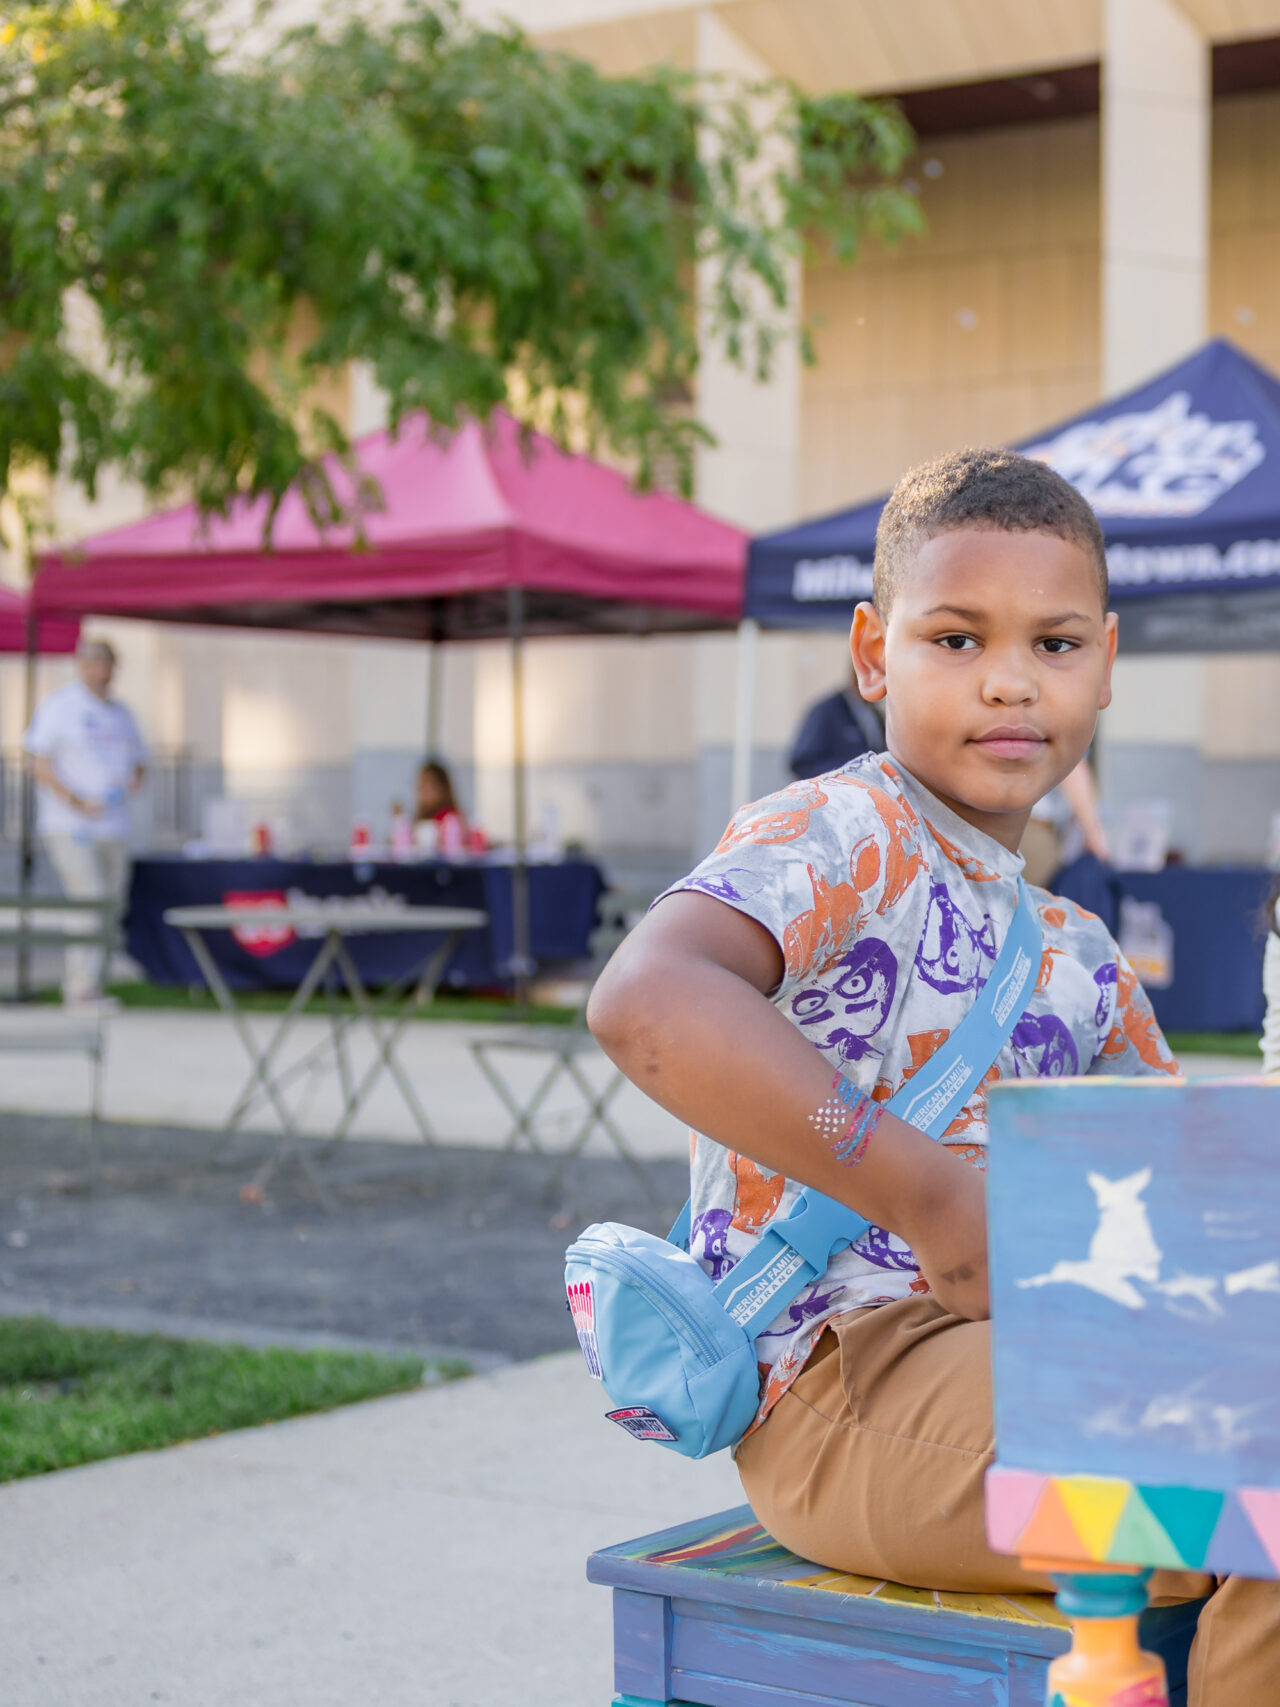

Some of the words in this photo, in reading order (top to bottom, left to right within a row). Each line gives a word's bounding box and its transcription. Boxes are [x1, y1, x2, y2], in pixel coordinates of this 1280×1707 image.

[908, 1087, 943, 1127] MERICAN
[941, 1059, 967, 1092] FAMILY
[919, 1067, 972, 1131] NSURANCE
[728, 1278, 770, 1320] MERICAN
[766, 1249, 799, 1281] FAMILY
